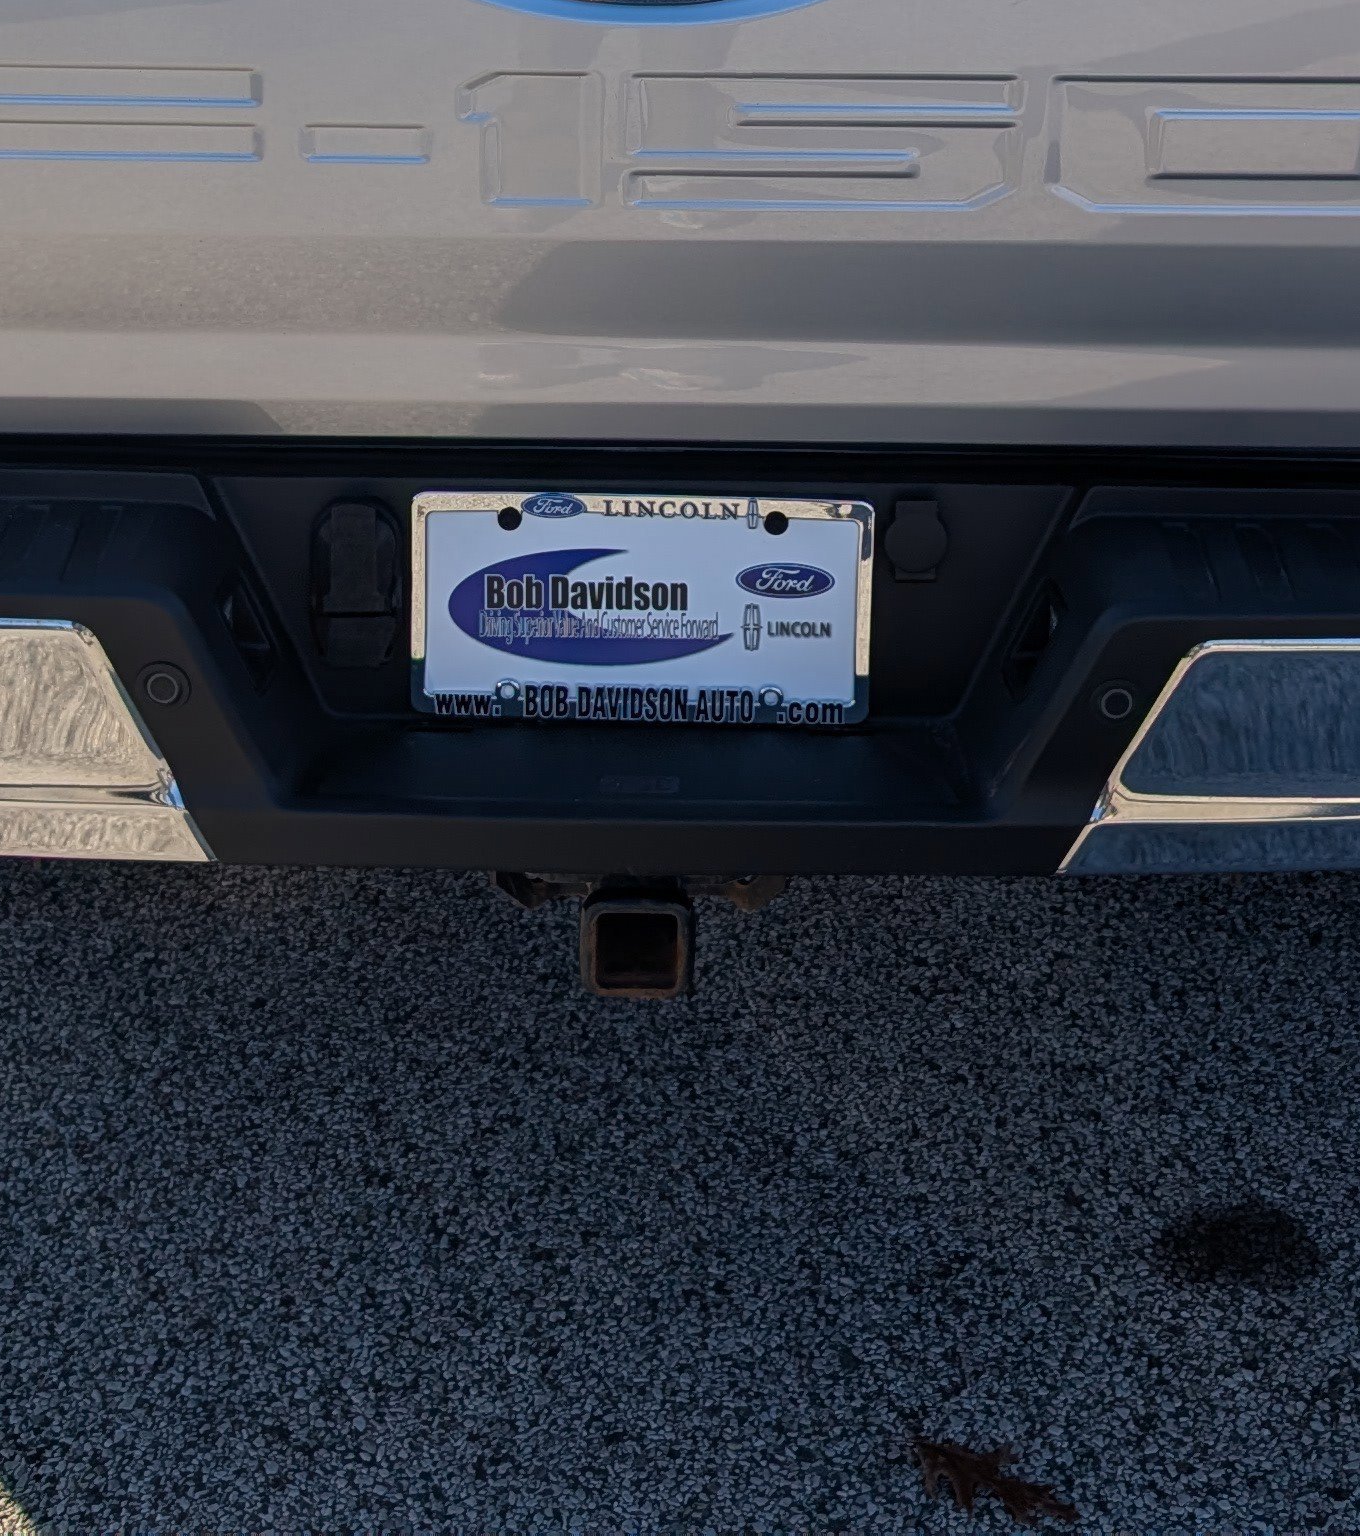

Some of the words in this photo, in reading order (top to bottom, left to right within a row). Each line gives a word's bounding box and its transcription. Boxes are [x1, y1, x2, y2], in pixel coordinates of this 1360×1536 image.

[532, 498, 575, 515] Ford
[602, 499, 741, 521] LINCOLN
[486, 574, 543, 610] Bob
[550, 574, 689, 611] Davidson
[755, 567, 815, 592] Ford
[478, 610, 513, 646] Driving
[580, 610, 600, 639] And
[600, 611, 646, 639] Customer
[646, 611, 680, 639] Service
[680, 611, 719, 639] Forward
[766, 620, 833, 639] LINCOLN
[523, 683, 570, 718] BOB
[575, 685, 688, 722] DAVIDSON
[694, 688, 755, 723] AUTO
